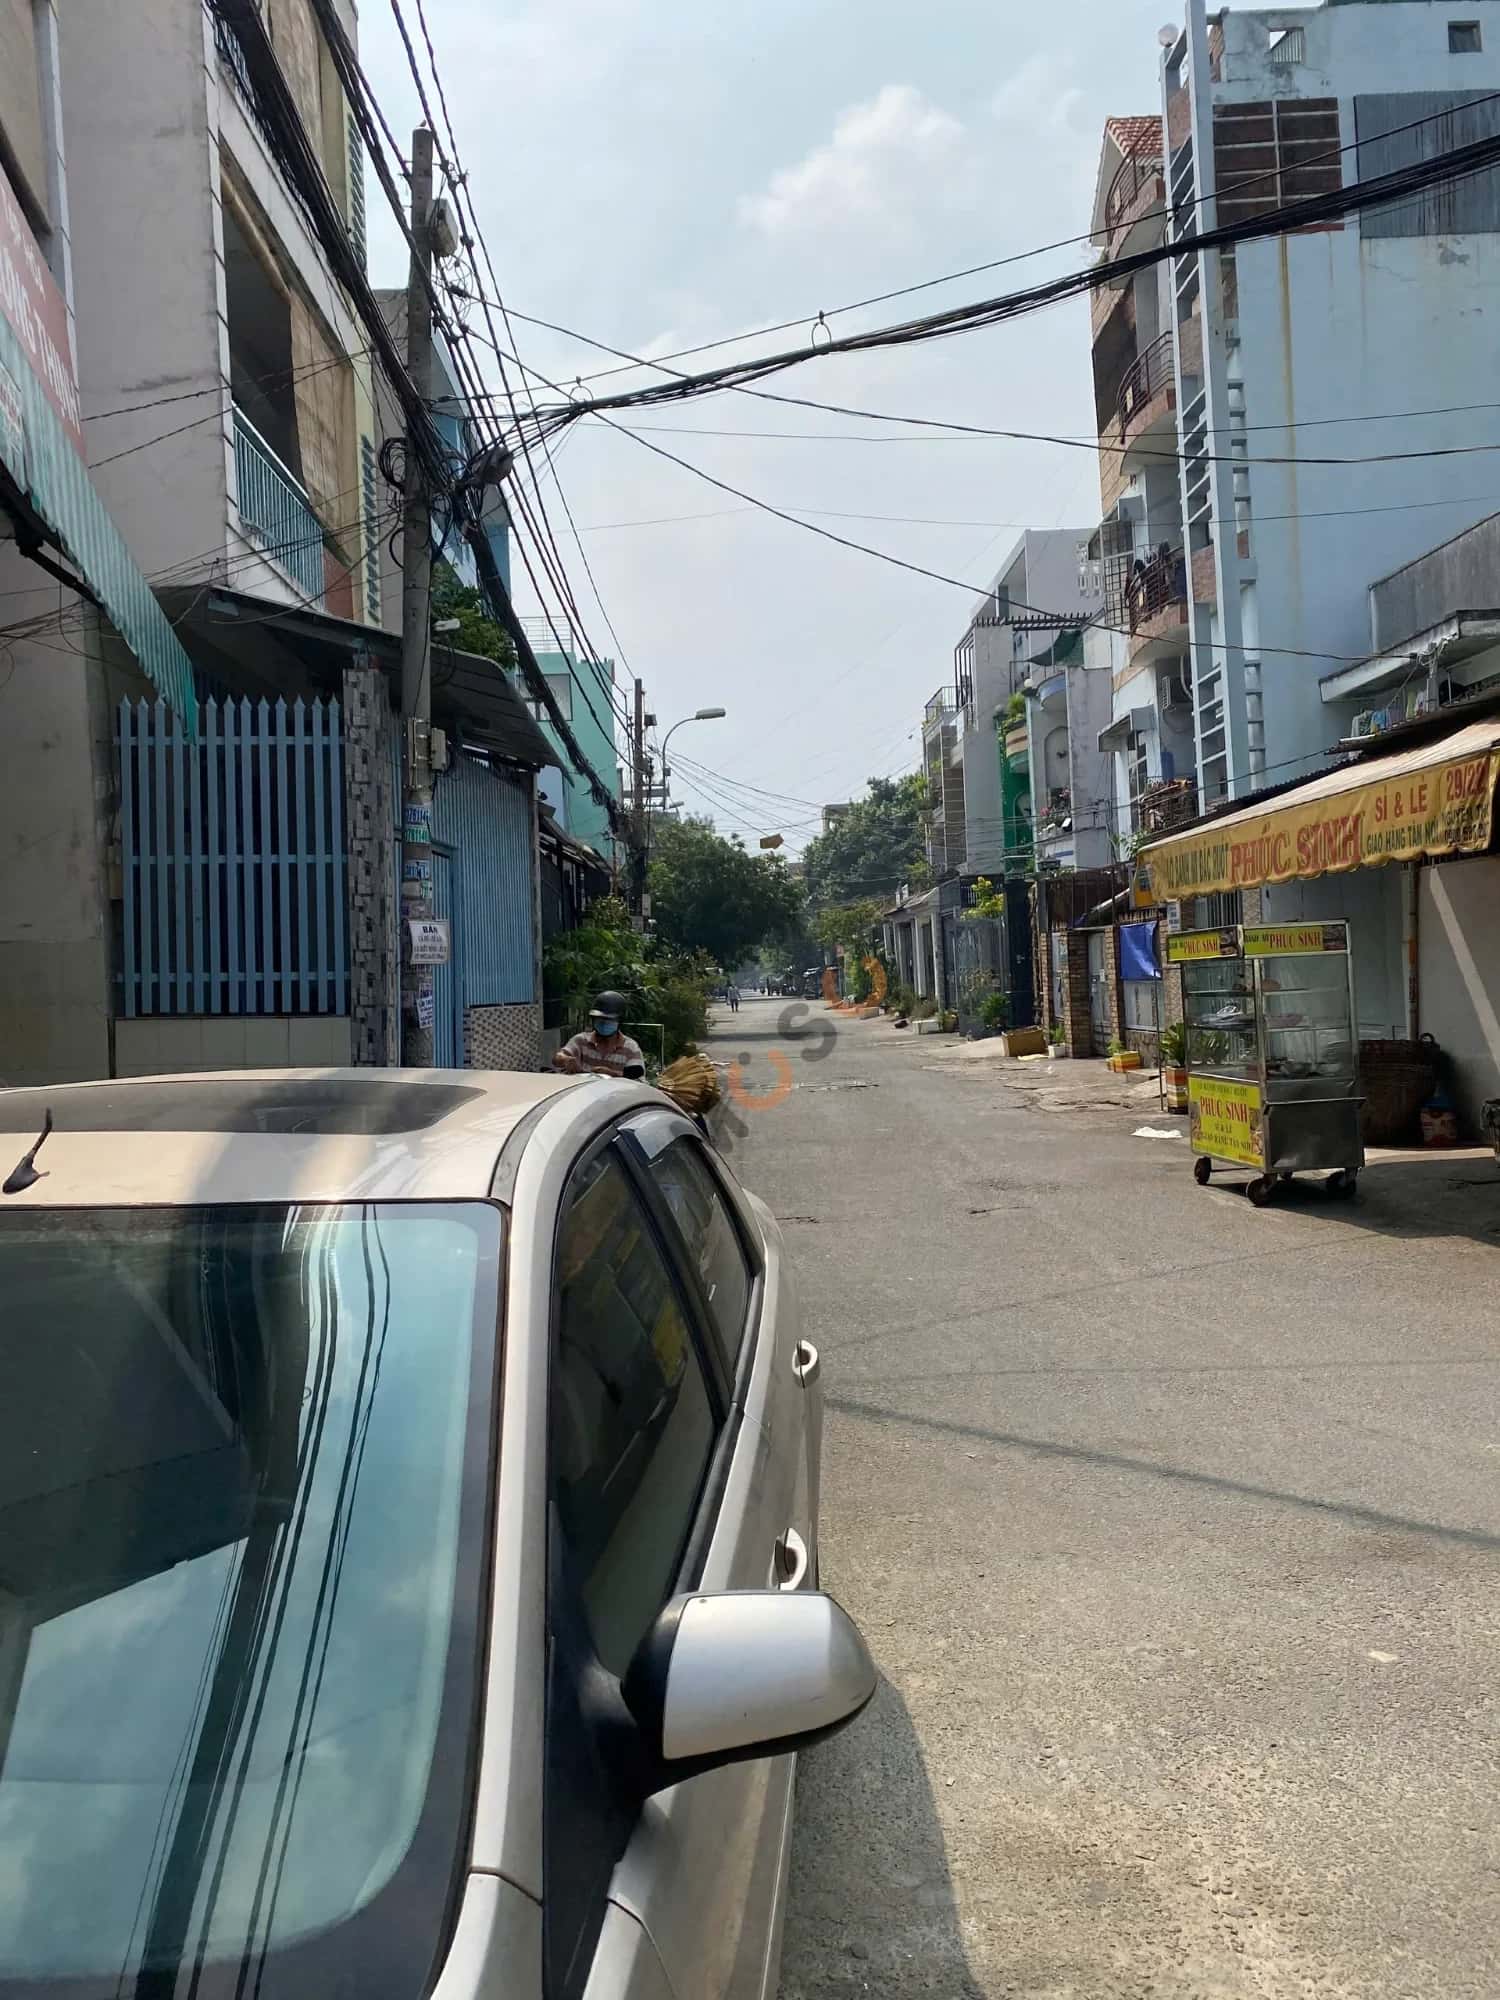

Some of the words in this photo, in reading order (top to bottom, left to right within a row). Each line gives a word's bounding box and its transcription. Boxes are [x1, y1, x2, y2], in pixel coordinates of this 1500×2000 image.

[1394, 791, 1403, 818] &
[1231, 822, 1291, 884] PHÚC
[1297, 814, 1363, 872] SINH
[1367, 833, 1383, 856] GIAO
[1298, 931, 1321, 947] SINH
[1225, 1103, 1248, 1124] SINH
